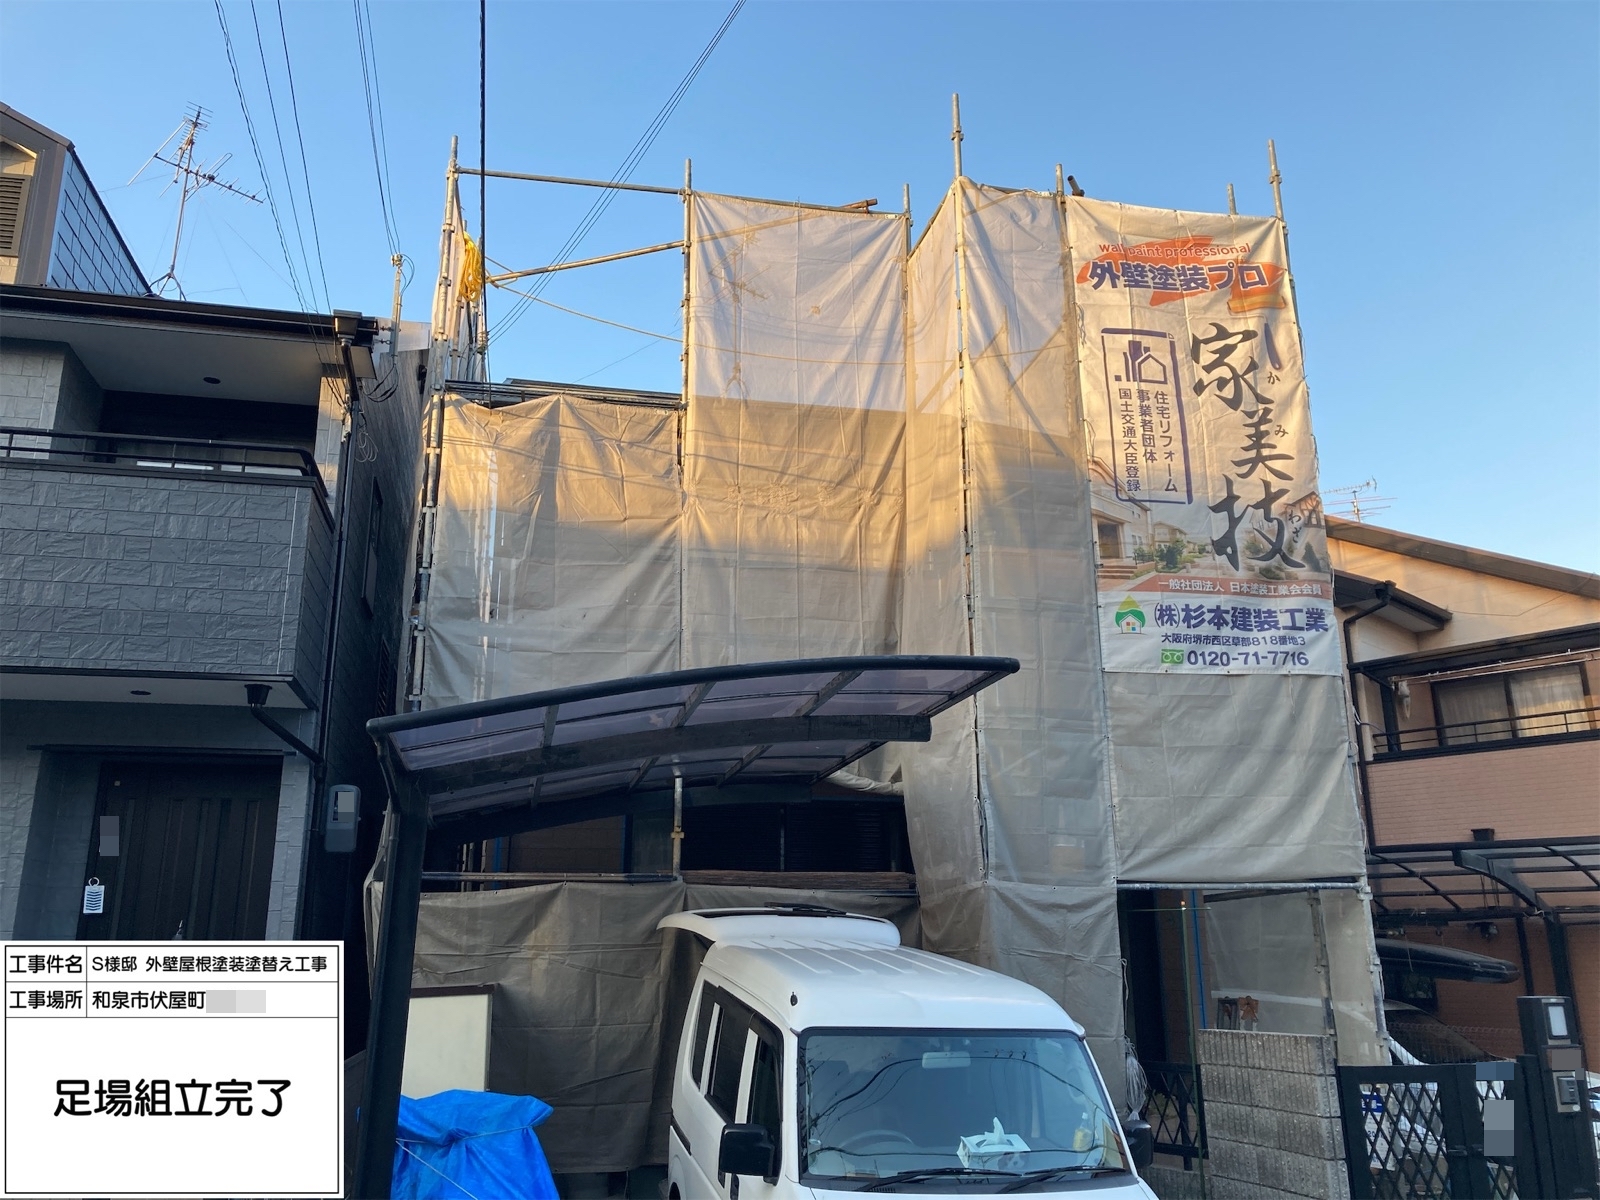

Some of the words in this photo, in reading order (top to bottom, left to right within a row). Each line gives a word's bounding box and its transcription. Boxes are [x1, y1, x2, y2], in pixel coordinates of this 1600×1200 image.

[1129, 245, 1162, 258] paint
[1165, 243, 1251, 258] professional
[1090, 261, 1268, 292] 外壁塗装プロ
[1267, 371, 1281, 385] か
[1136, 388, 1158, 465] 事業者団体
[1274, 424, 1289, 438] み
[1118, 387, 1141, 493] 国土交通大臣登録
[1154, 390, 1178, 493] 住宅リフォーム
[1191, 322, 1305, 571] 家美技
[1158, 578, 1225, 593] 一般社団法人
[1230, 582, 1323, 596] 日本塗装工業会会員
[1187, 650, 1310, 667] 0120-71-7716
